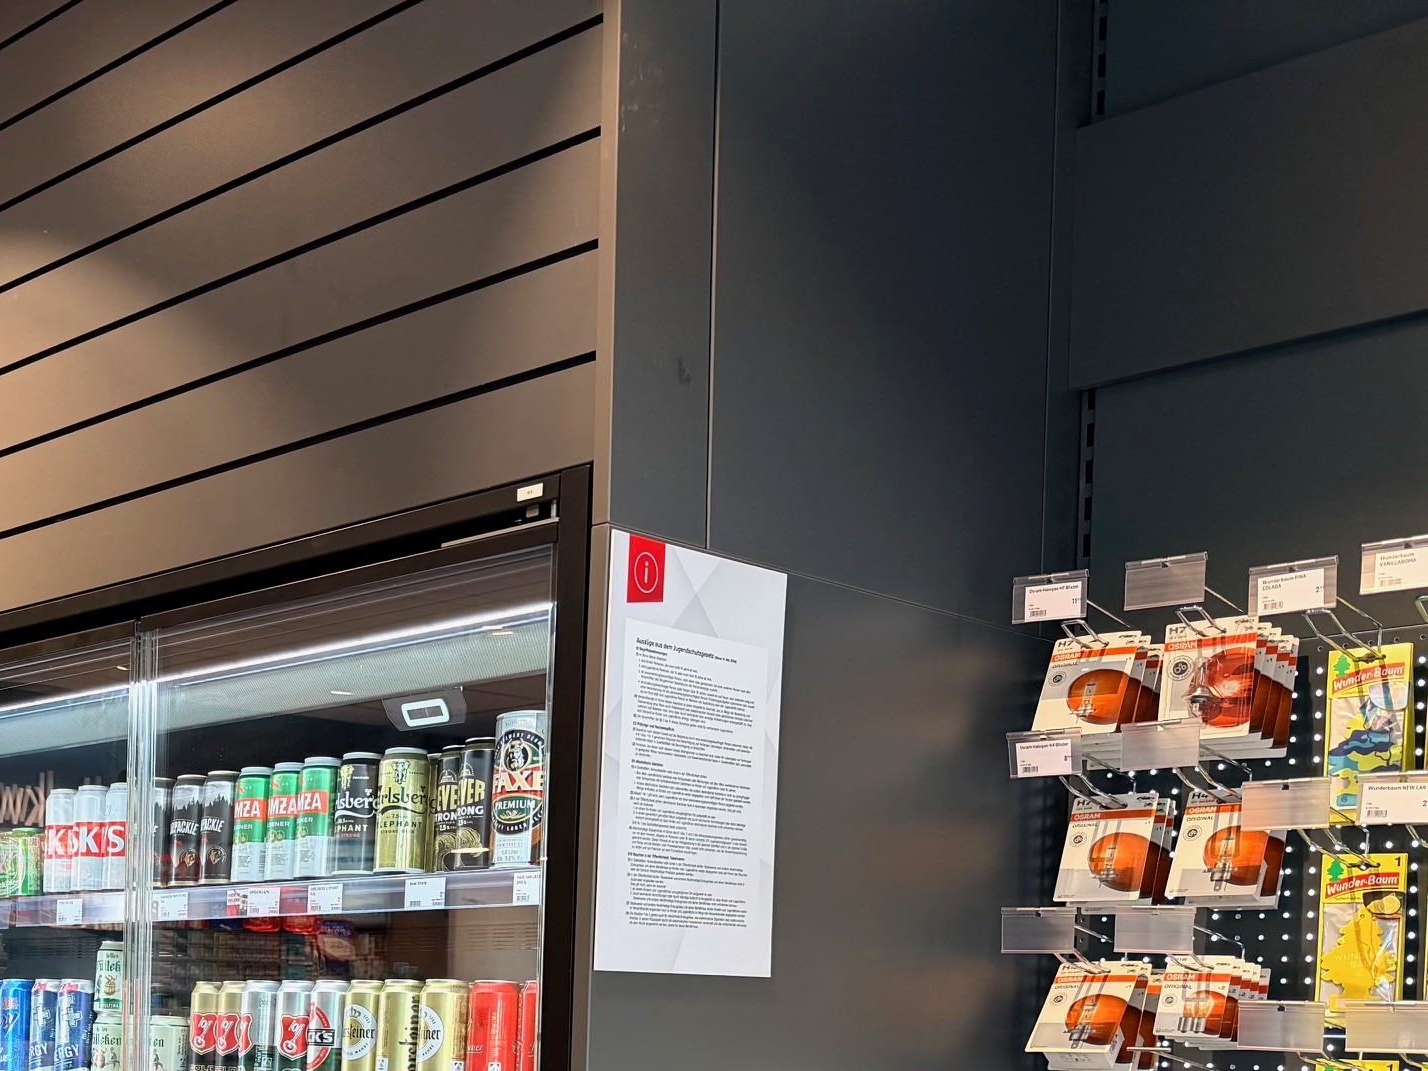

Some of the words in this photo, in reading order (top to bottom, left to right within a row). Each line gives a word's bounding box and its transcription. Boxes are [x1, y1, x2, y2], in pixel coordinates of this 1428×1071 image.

[1169, 626, 1186, 635] H7
[1167, 641, 1197, 651] OSRAM
[1053, 652, 1081, 662] OSRAM
[1333, 665, 1404, 692] Wunder-Baum
[492, 770, 543, 792] FAXE
[268, 797, 297, 815] MŻA
[297, 792, 321, 811] MŻA
[494, 800, 535, 812] PREMIUM
[234, 800, 261, 818] MŻA
[458, 805, 484, 817] RONG
[1188, 806, 1217, 814] OSRAM
[1073, 812, 1101, 821] OSRAM
[1394, 857, 1402, 867] 1
[1326, 873, 1398, 895] Wunder-Baum
[1056, 975, 1084, 984] OSRAM
[1166, 972, 1195, 982] OSRAM
[54, 1043, 80, 1063] ERGY
